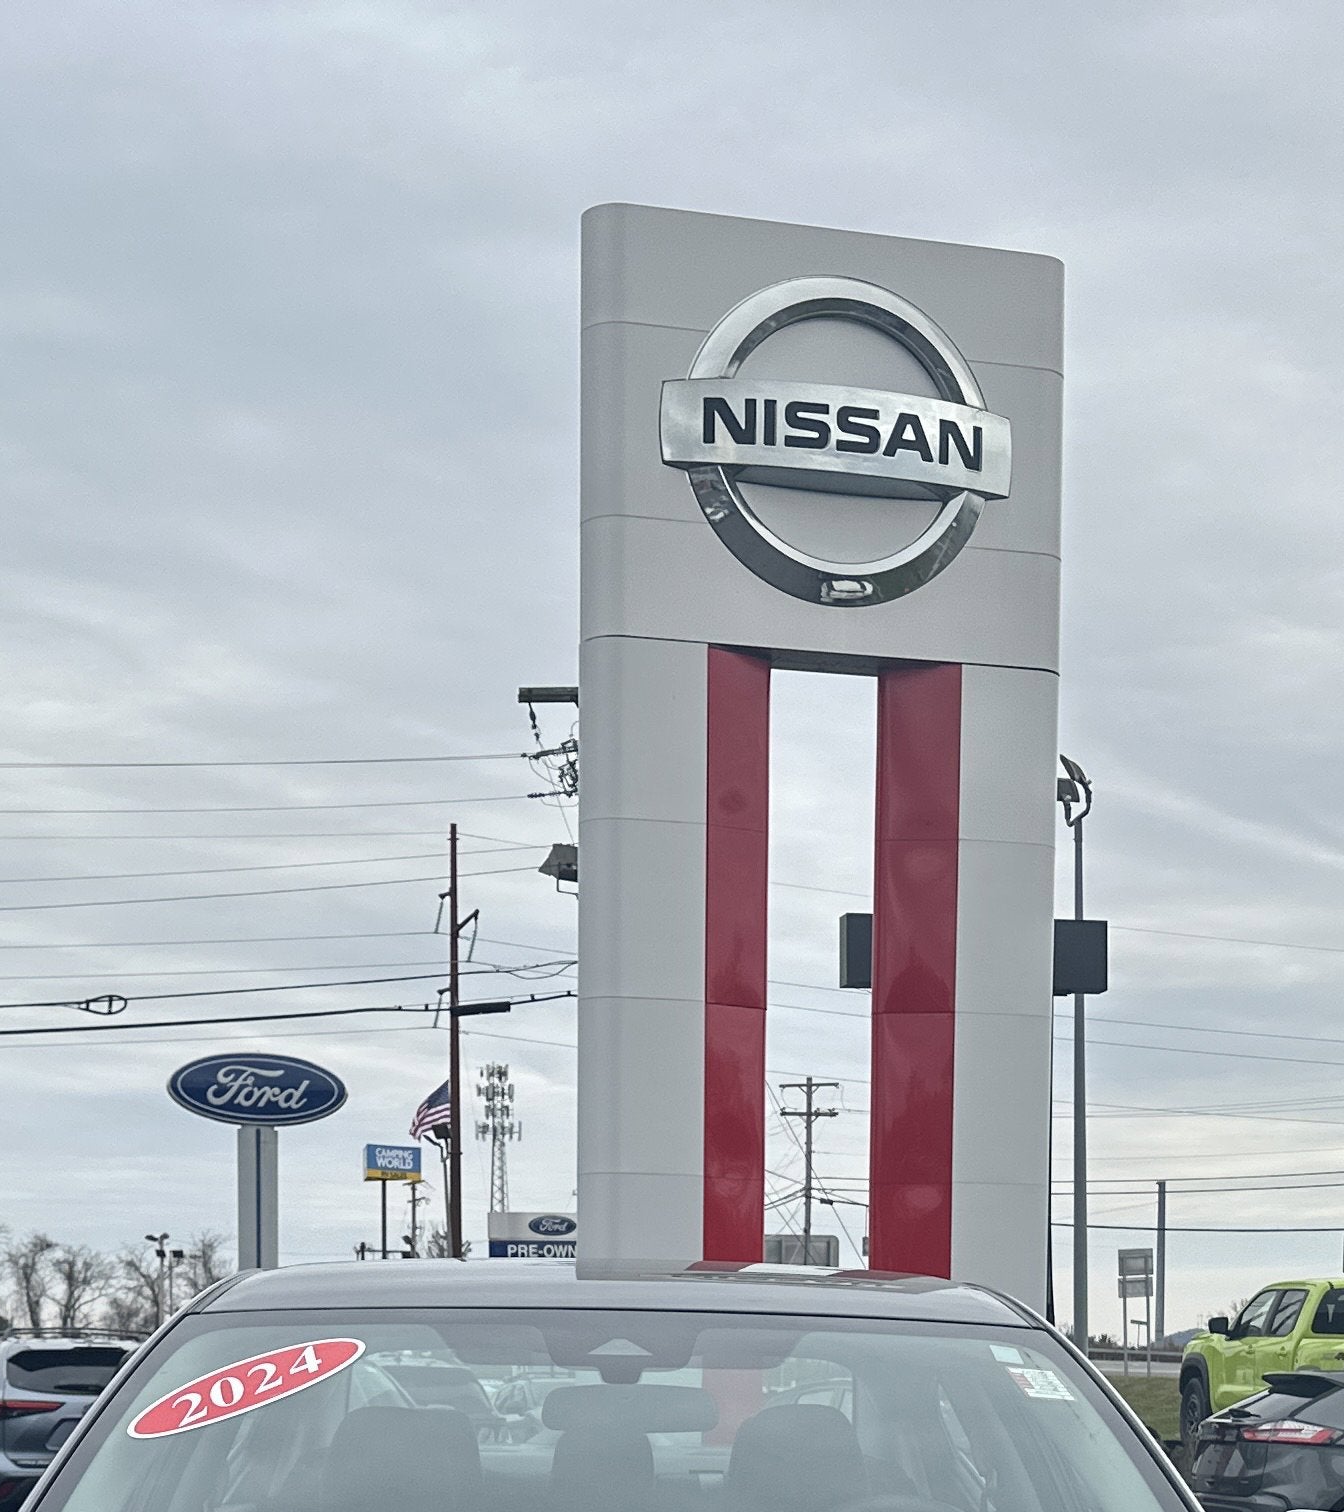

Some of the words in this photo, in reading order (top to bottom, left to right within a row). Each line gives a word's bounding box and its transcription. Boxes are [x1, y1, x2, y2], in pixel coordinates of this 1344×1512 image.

[702, 396, 984, 473] NISSAN
[207, 1065, 310, 1109] Ford
[376, 1147, 413, 1160] CAMPING
[376, 1157, 414, 1169] WORLD
[538, 1219, 569, 1232] Ford
[171, 1345, 322, 1427] 2024
